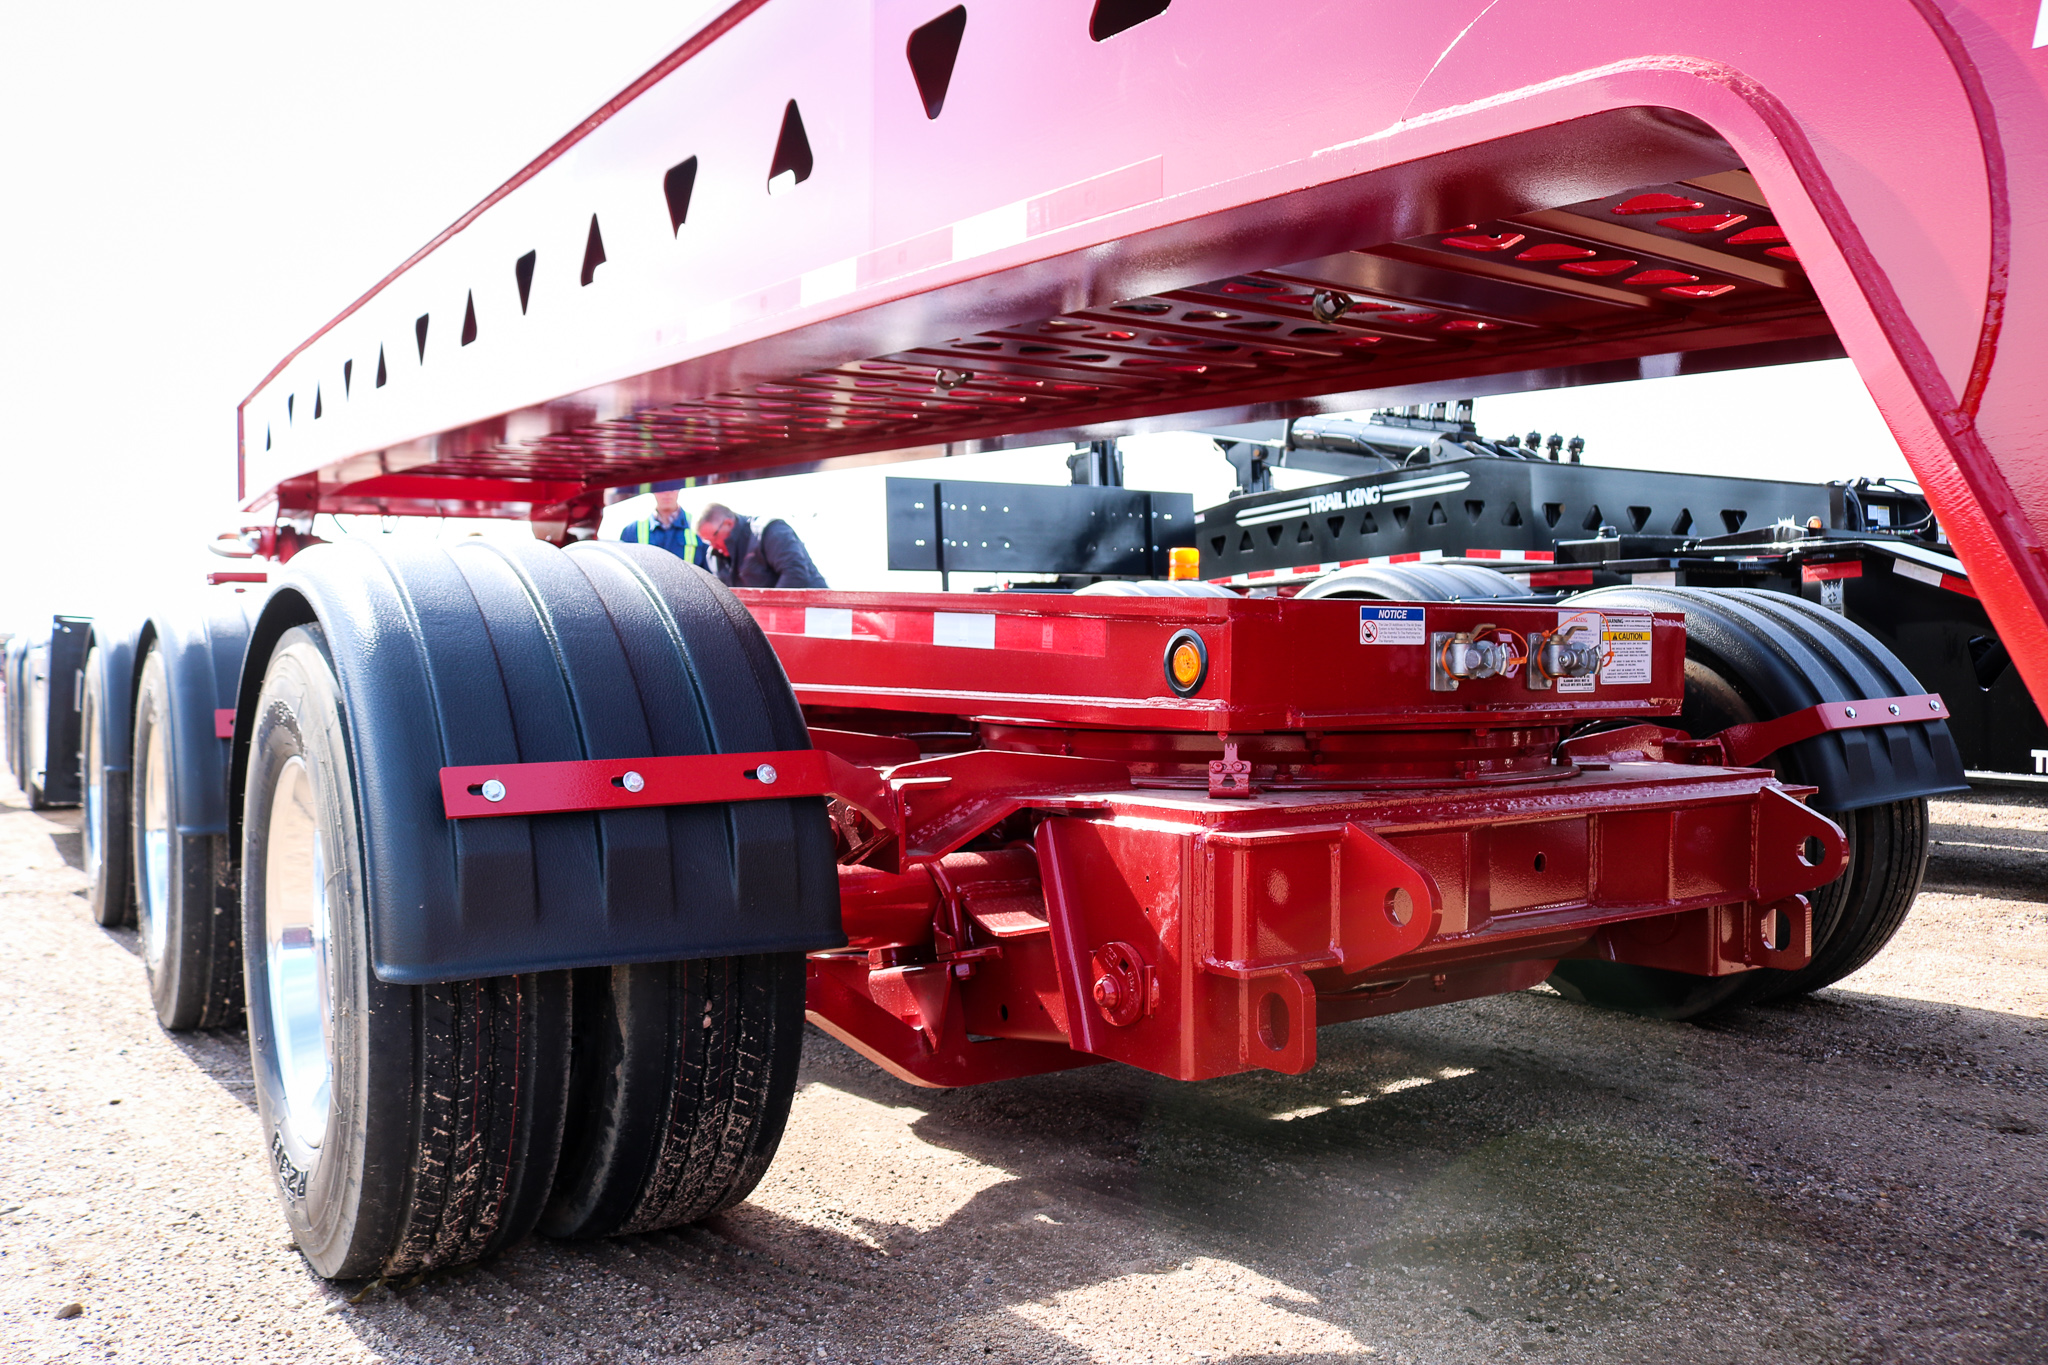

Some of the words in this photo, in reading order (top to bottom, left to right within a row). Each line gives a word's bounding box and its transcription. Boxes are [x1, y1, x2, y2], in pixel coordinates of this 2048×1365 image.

[1309, 492, 1346, 514] TRAIL
[1346, 486, 1380, 508] KING
[1378, 610, 1408, 619] NOTICE
